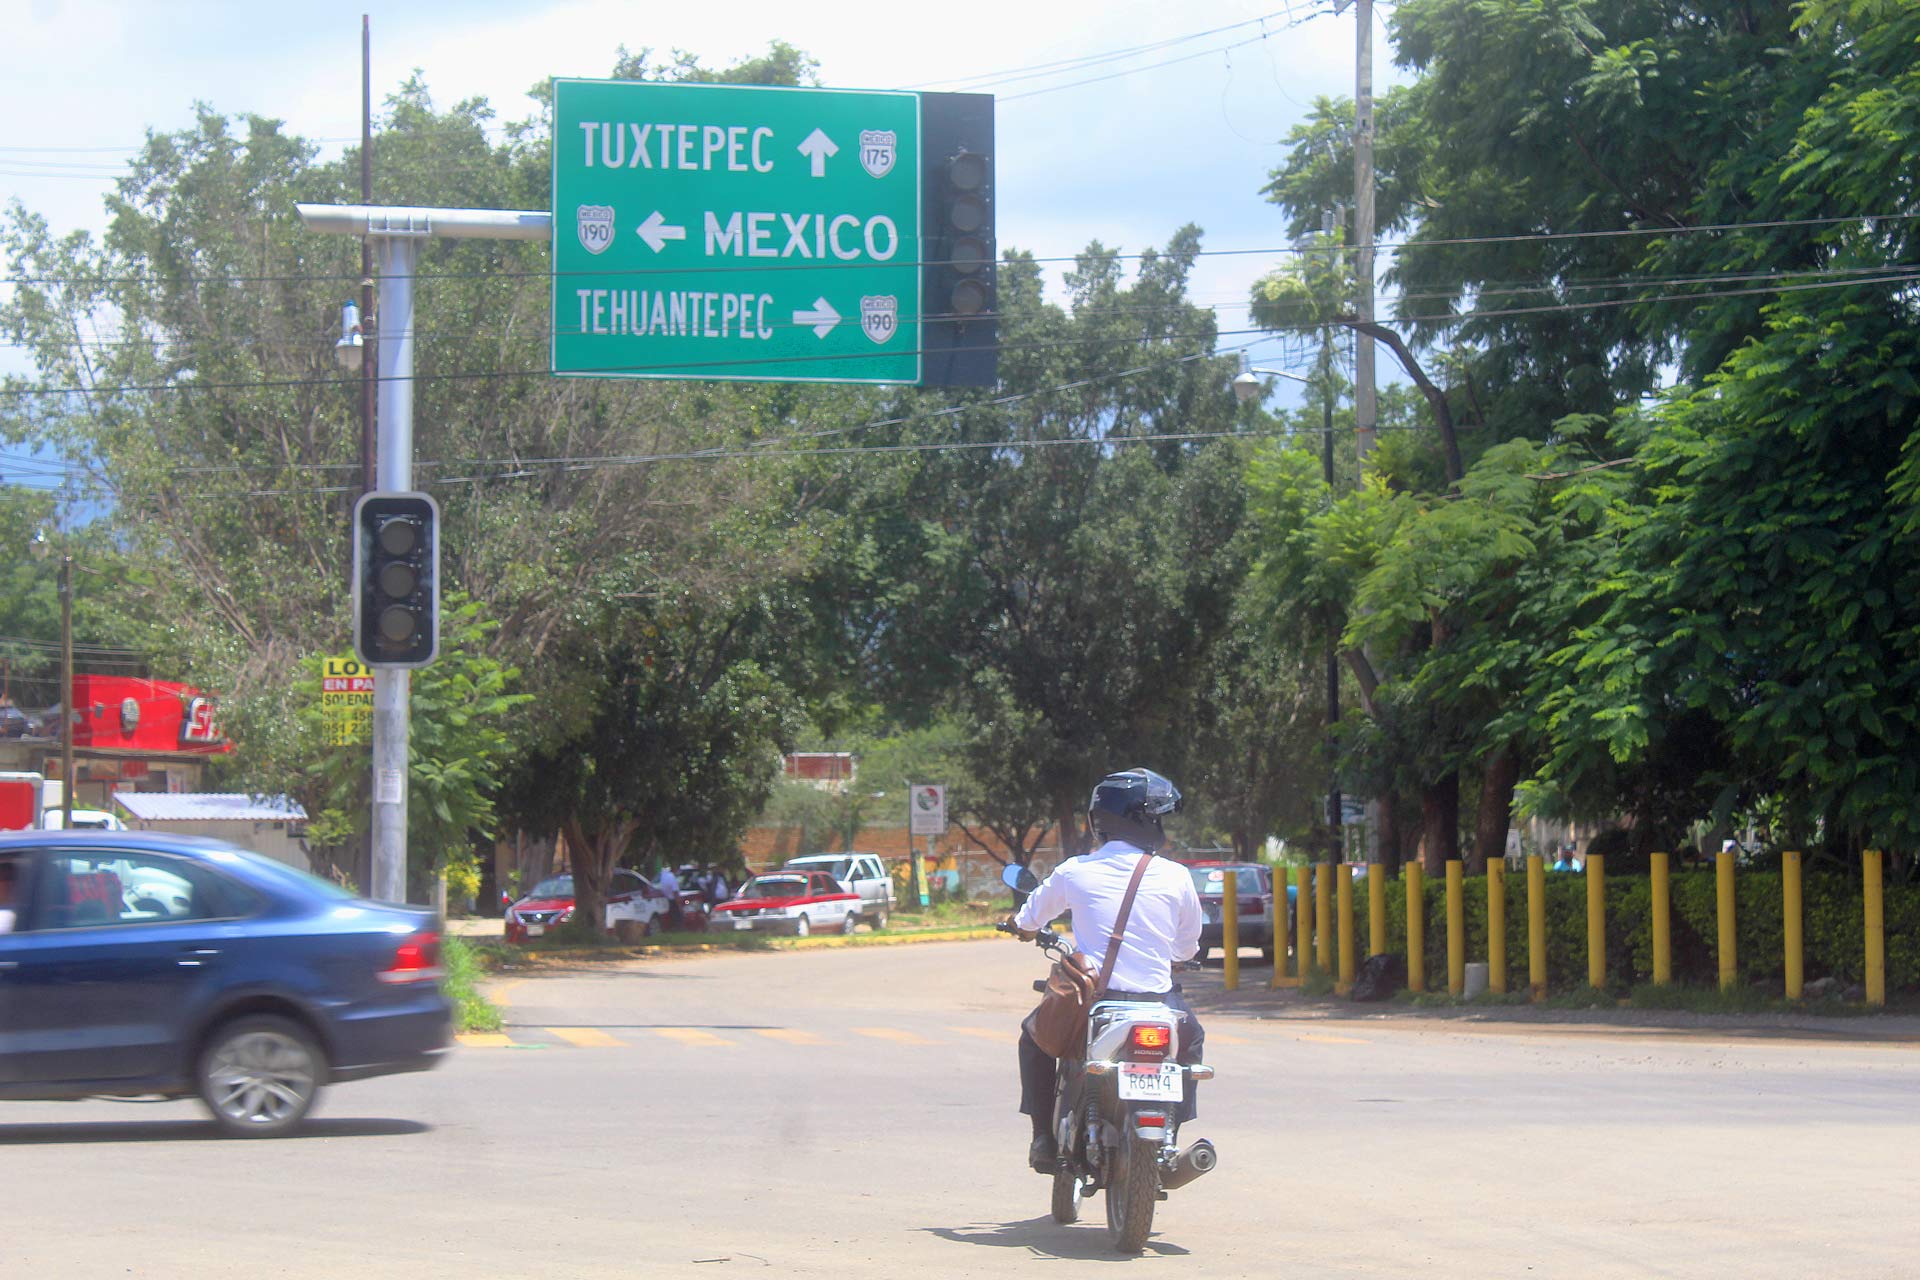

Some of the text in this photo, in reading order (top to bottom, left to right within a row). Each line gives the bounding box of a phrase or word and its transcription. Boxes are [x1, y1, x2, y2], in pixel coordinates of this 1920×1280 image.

[579, 121, 774, 173] TUXTEPEC
[867, 149, 890, 166] 175
[583, 224, 609, 241] 190
[704, 210, 899, 261] MEXICO
[576, 288, 774, 340] TEHUANTEPEC
[867, 314, 891, 331] 190
[325, 679, 348, 690] EN
[1130, 1074, 1171, 1090] R6AY4
